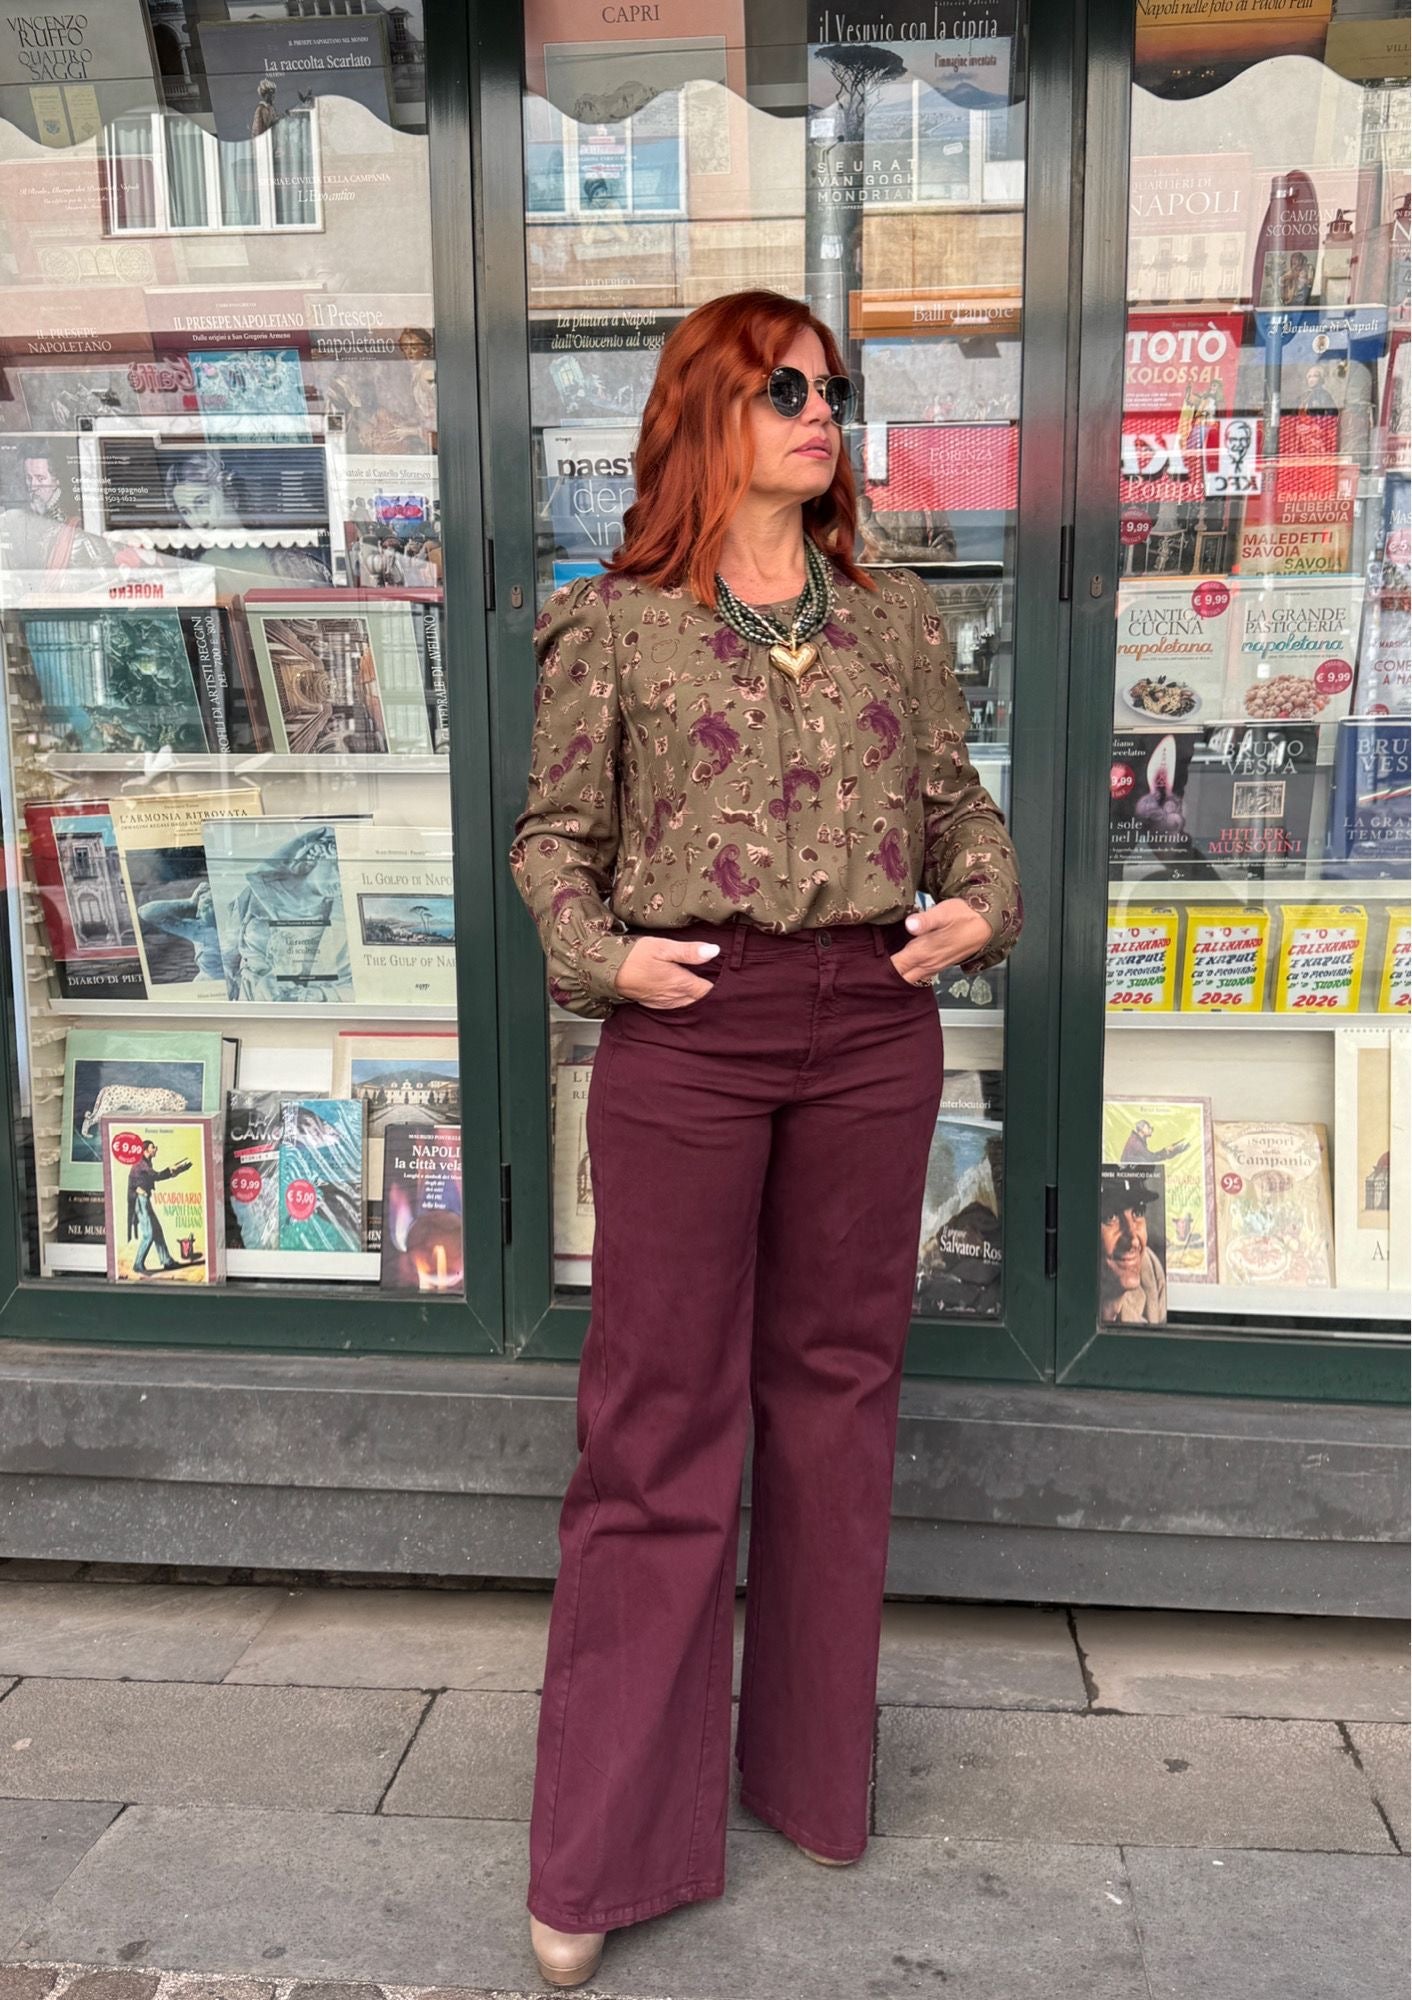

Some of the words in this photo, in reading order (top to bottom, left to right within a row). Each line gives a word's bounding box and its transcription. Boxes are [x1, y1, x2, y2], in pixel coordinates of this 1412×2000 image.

[601, 4, 660, 24] CAPRI
[1136, 0, 1178, 18] Napoli
[1181, 0, 1206, 13] nelle
[7, 15, 88, 31] VINCENZO
[820, 10, 829, 43] il
[836, 14, 894, 43] Vesuvio
[901, 21, 927, 41] con
[934, 6, 946, 41] la
[953, 9, 998, 50] cipria
[18, 28, 84, 47] RUFFO
[18, 49, 93, 67] QUATTRO
[264, 58, 276, 71] La
[281, 55, 325, 70] raccolta
[326, 53, 371, 68] Scarlato
[31, 63, 88, 80] SAGGI
[818, 159, 915, 173] SEURAT
[818, 175, 853, 187] VAN
[866, 173, 914, 185] GOGH
[818, 188, 914, 203] MONDRIAN
[1131, 190, 1241, 216] NAPOLI
[174, 317, 185, 330] IL
[186, 315, 232, 329] PRESEPE
[233, 313, 304, 328] NAPOLETANO
[327, 303, 383, 333] Presepe
[557, 313, 570, 328] La
[571, 314, 609, 331] pittura
[611, 316, 619, 326] a
[621, 311, 656, 330] Napoli
[1343, 318, 1379, 334] Napoli
[36, 329, 47, 340] IL
[50, 327, 98, 339] PRESEPE
[27, 340, 112, 353] NAPOLETANO
[318, 331, 394, 360] napoletano
[626, 332, 640, 347] ad
[643, 332, 666, 350] oggi
[1127, 321, 1228, 364] TOTÒ
[1284, 501, 1350, 513] FILIBERTO
[1282, 512, 1296, 523] DI
[1299, 511, 1349, 523] SAVOIA
[1243, 531, 1333, 546] MALEDETTI
[1242, 545, 1300, 559] SAVOIA
[1284, 557, 1342, 570] SAVOIA
[1193, 594, 1202, 606] €
[1204, 594, 1229, 606] 9,99
[1272, 607, 1347, 621] GRANDE
[1128, 620, 1203, 637] CUCINA
[1245, 620, 1343, 634] PASTICCERIA
[191, 616, 209, 661] REGGINI
[1117, 637, 1214, 661] napoletana
[1241, 633, 1344, 660] napoletana
[1316, 673, 1325, 683] €
[1327, 671, 1351, 684] 9,99
[119, 812, 181, 825] L'ARMONIA
[185, 808, 248, 820] RITROVATA
[1117, 816, 1143, 829] sole
[1135, 830, 1189, 843] labirinto
[1219, 828, 1284, 841] HITLER
[1207, 840, 1302, 854] MUSSOLINI
[67, 975, 105, 986] DIARIO
[107, 975, 119, 984] DI
[1109, 991, 1153, 1006] 2026
[1197, 991, 1243, 1005] 2026
[1292, 994, 1339, 1008] 2026
[112, 1141, 120, 1152] €
[122, 1142, 143, 1154] 9,99
[412, 1145, 461, 1158] NAPOLI
[395, 1157, 406, 1169] la
[409, 1158, 436, 1170] città
[1236, 1154, 1312, 1168] Campania
[240, 1178, 260, 1190] 9,99
[295, 1190, 314, 1203] 5,00
[940, 1234, 981, 1257] Salvator
[983, 1240, 1002, 1261] Ros
